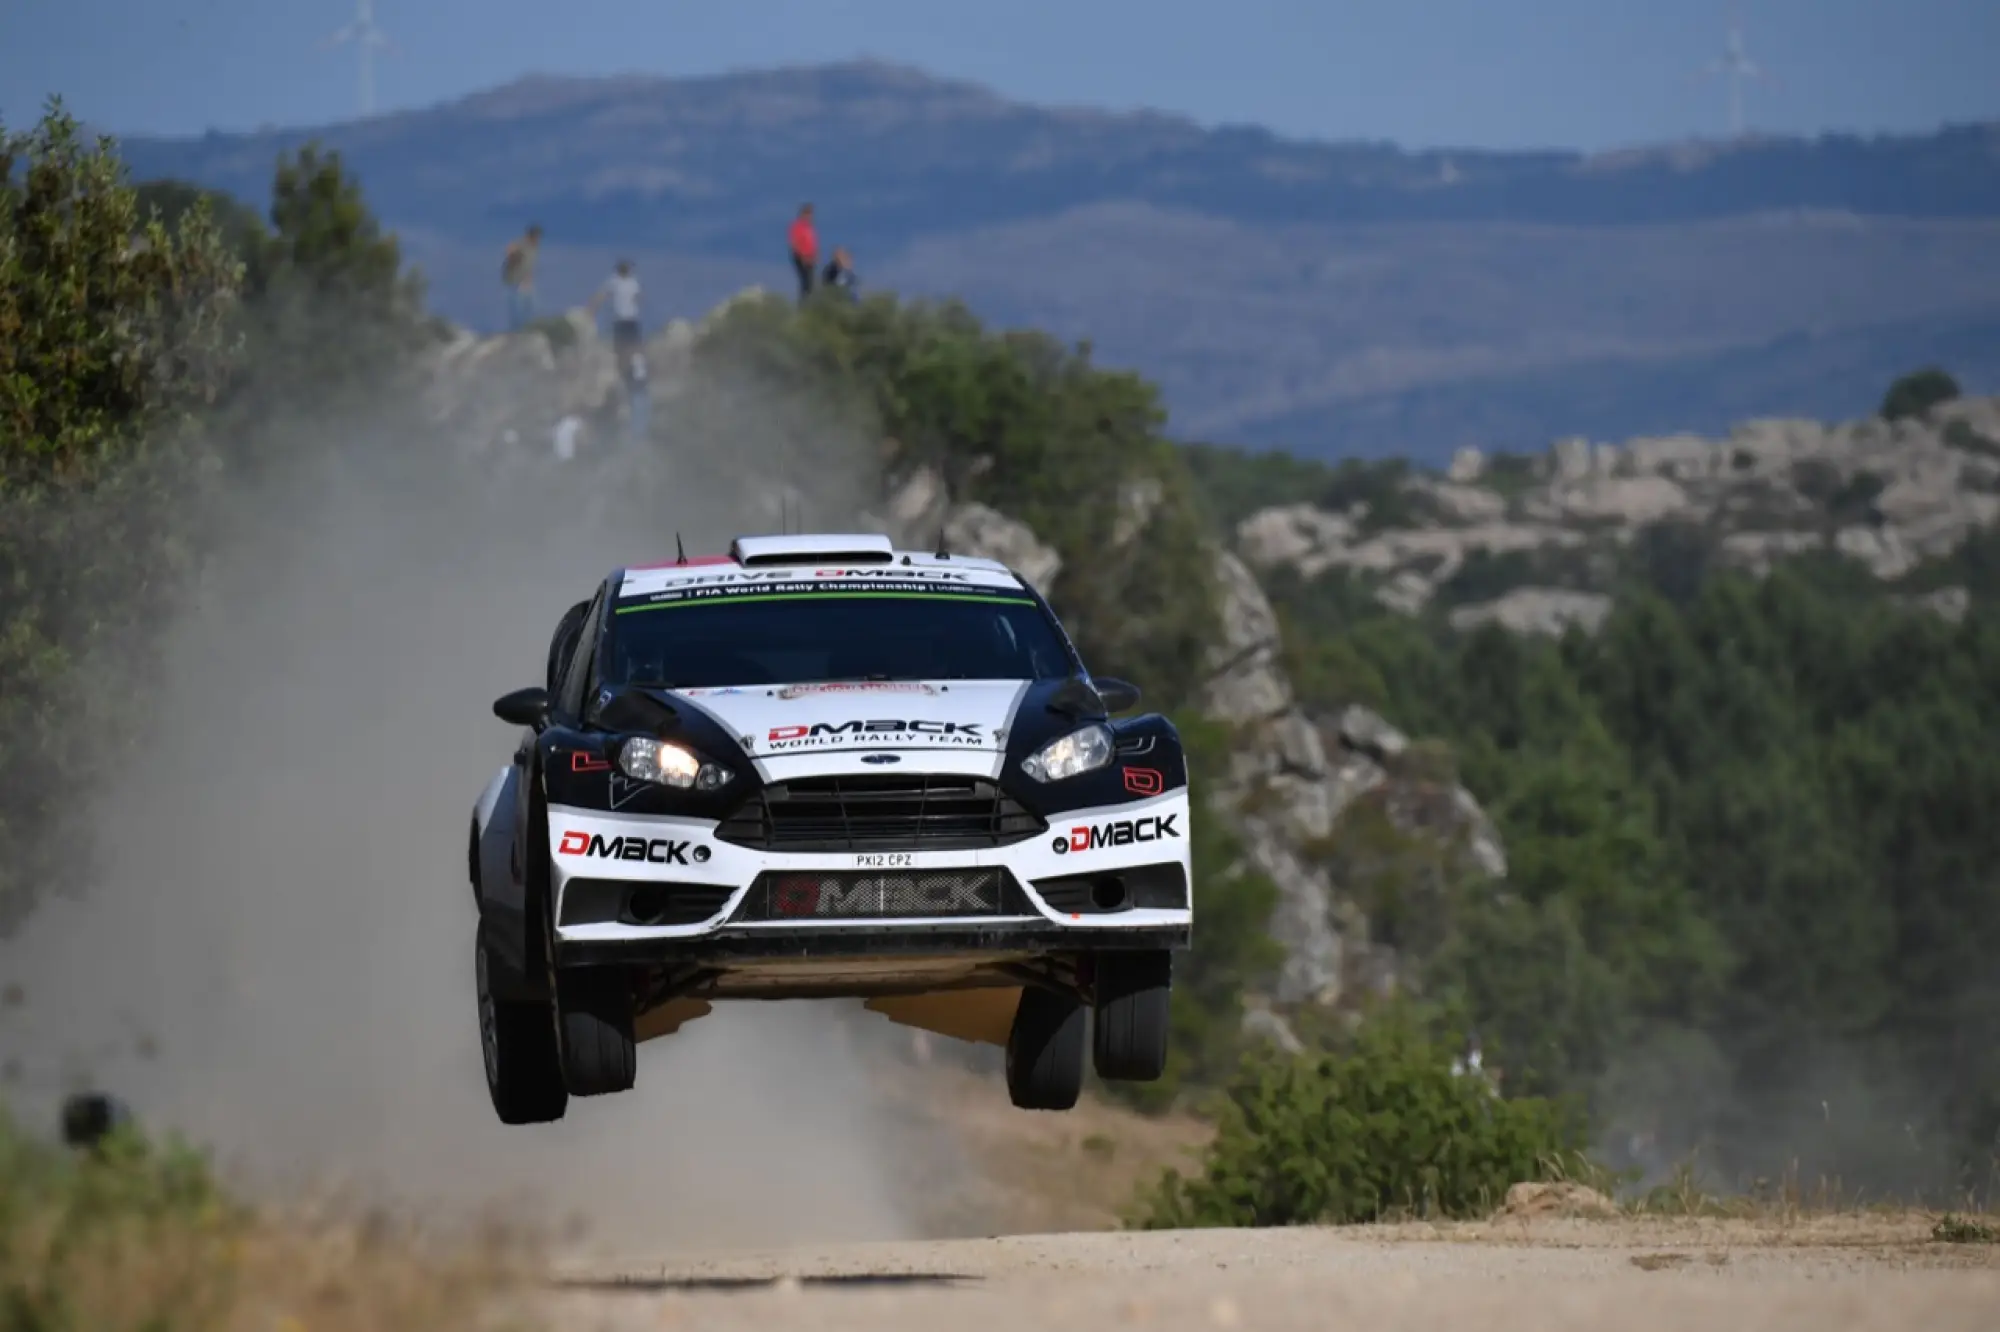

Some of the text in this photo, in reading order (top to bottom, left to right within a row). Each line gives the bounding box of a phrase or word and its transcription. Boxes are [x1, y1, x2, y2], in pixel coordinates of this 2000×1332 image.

[665, 570, 793, 588] DRIVE
[696, 588, 723, 597] FIA
[726, 584, 771, 595] World
[775, 582, 814, 593] Rally
[819, 582, 927, 593] Championship
[768, 718, 983, 742] DMACK
[769, 732, 982, 750] WORLD RALLY TEAM
[1069, 813, 1181, 853] DMACK
[558, 830, 692, 866] DMACK
[857, 853, 912, 867] PX12 CPZ
